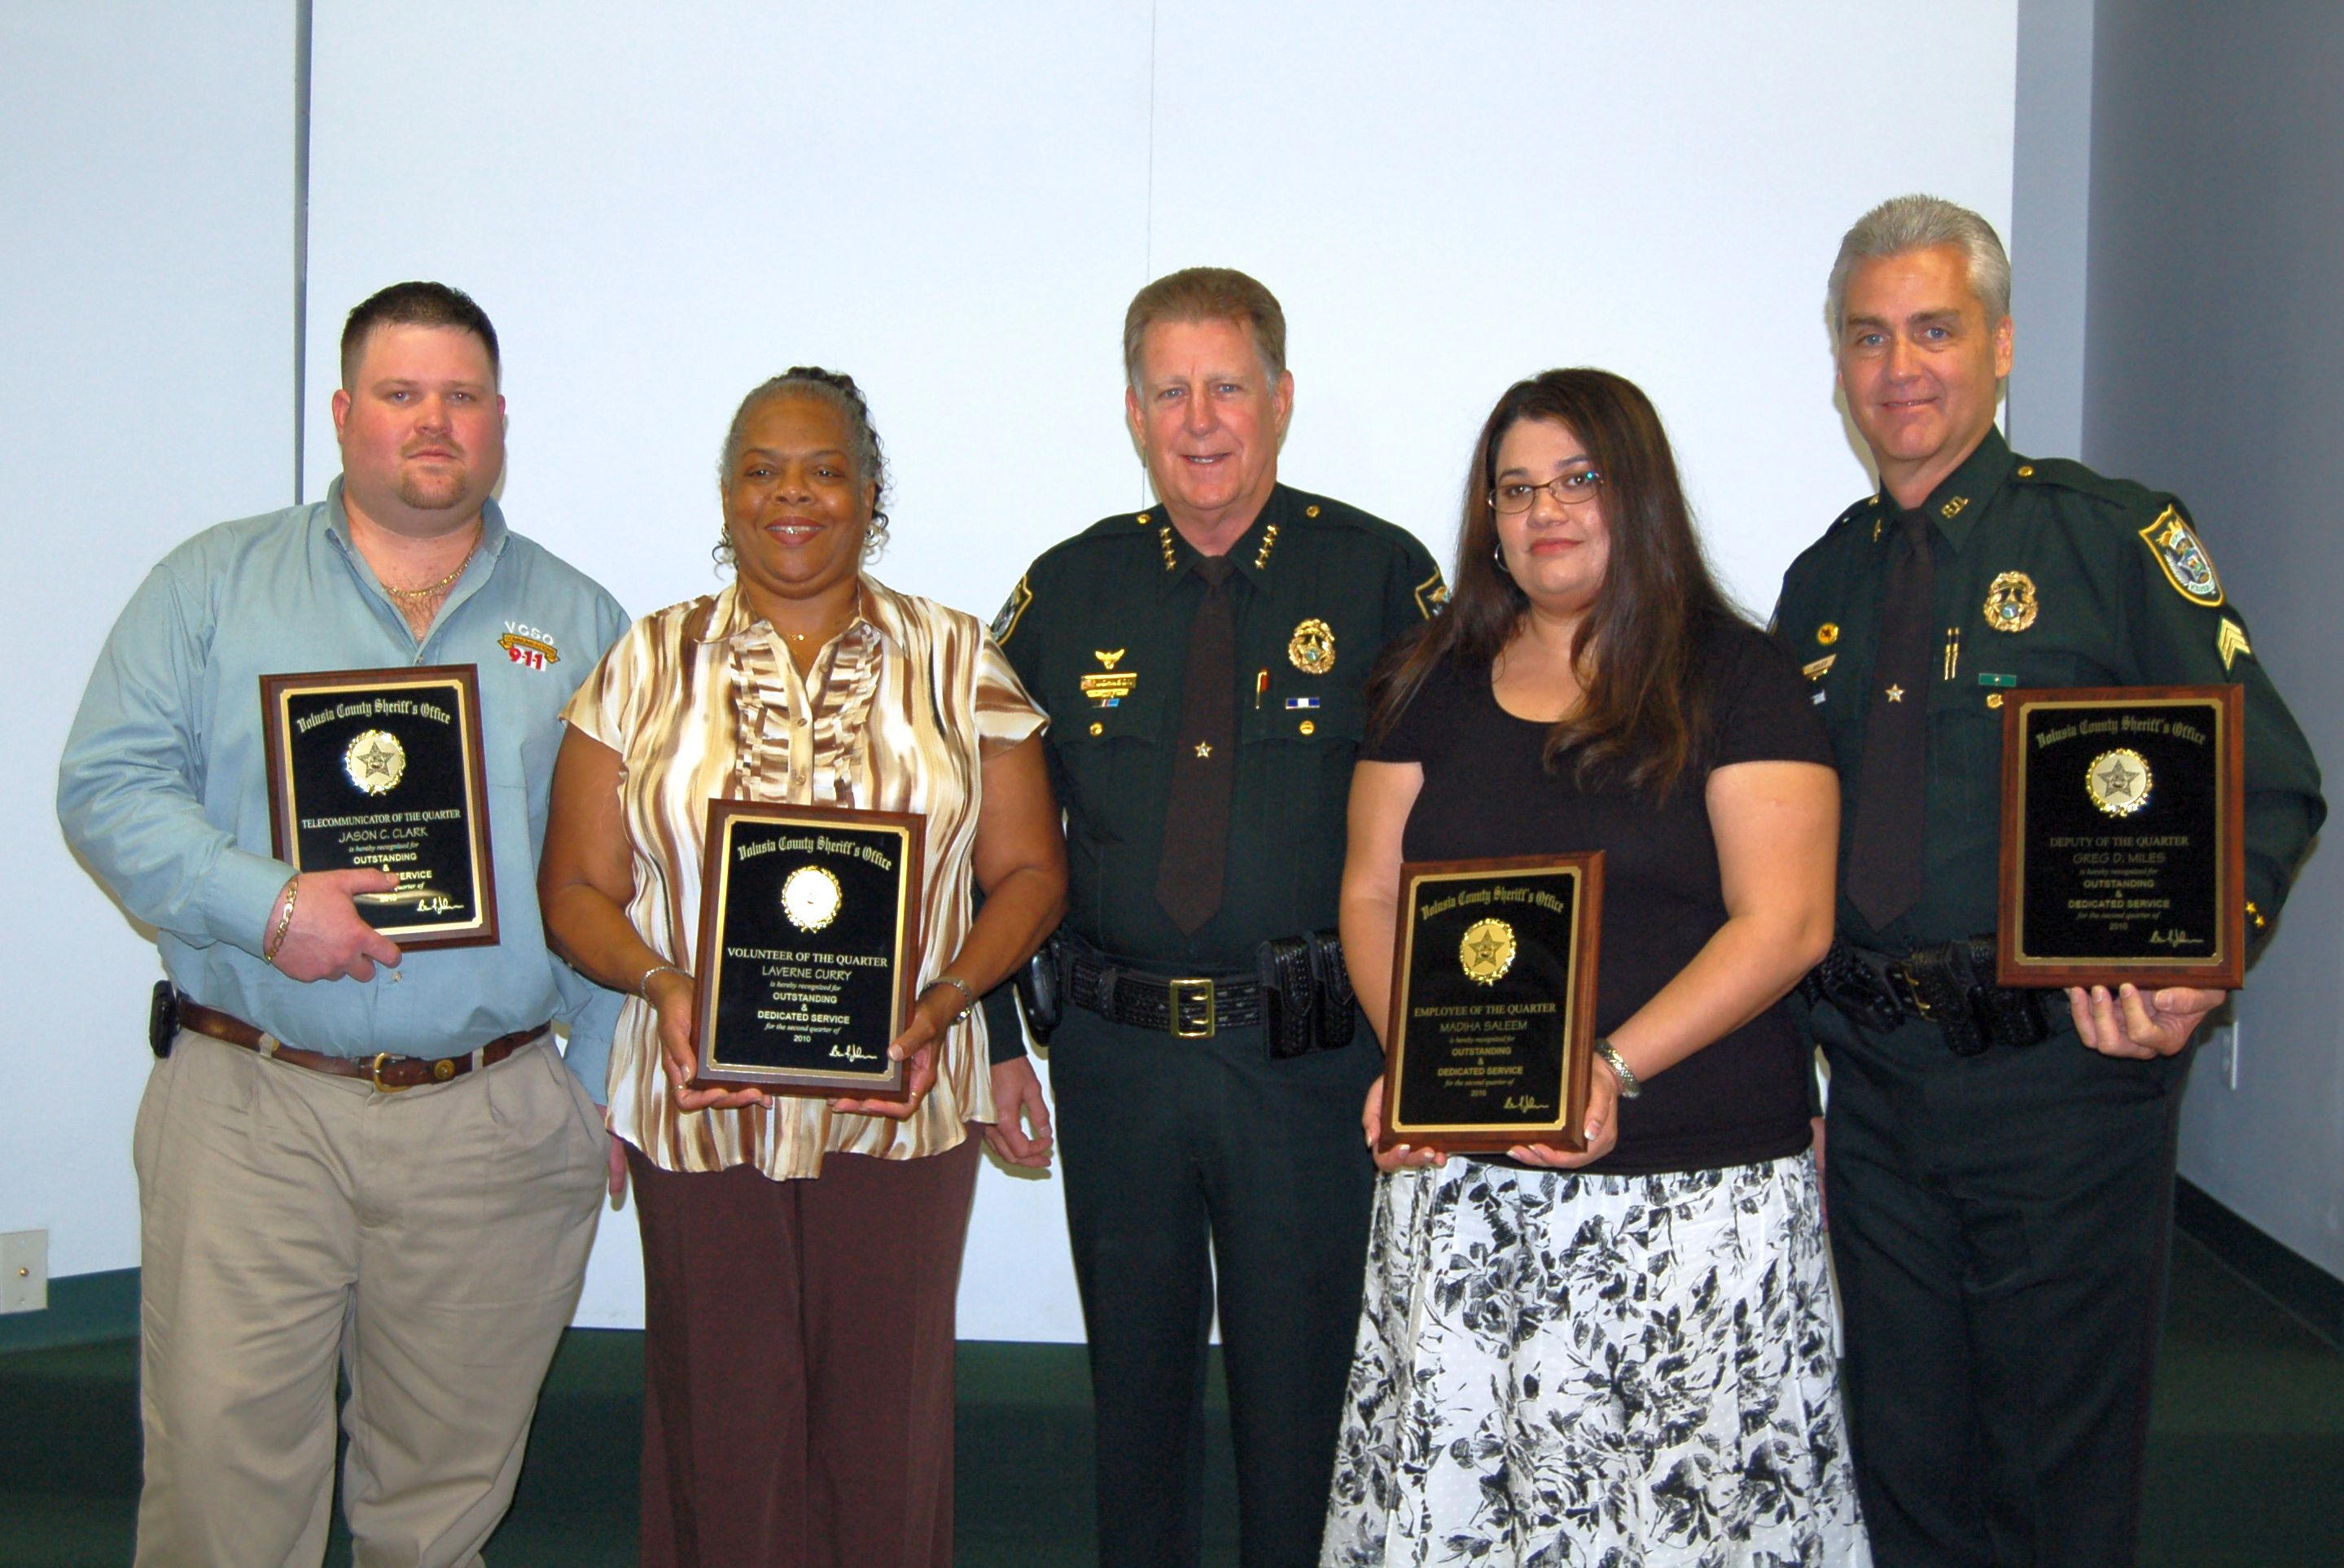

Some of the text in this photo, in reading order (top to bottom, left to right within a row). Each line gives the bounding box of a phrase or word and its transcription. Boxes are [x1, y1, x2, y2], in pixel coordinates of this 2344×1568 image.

[504, 620, 554, 646] VCSO
[296, 698, 450, 733] Volusia County Sheriff's Office
[2035, 715, 2206, 749] Volusia County Sheriff's Office
[301, 809, 461, 829] TELECOMMUNICATOR OF THE QUARTER
[339, 826, 428, 843] JASON C. CLARK
[2049, 835, 2189, 848] DEPUTY OF THE QUARTER
[353, 853, 418, 865] OUTSTANDING
[738, 835, 892, 871] Volusia County Sheriff's Office
[2072, 852, 2167, 865] GREG D. MILES
[383, 864, 390, 872] &
[2083, 879, 2155, 888] OUTSTANDING
[1421, 885, 1564, 921] Volusia County Sheriff's Office
[2068, 899, 2171, 909] DEDICATED SERVICE
[727, 947, 888, 968] VOLUNTEER OF THE QUARTER
[762, 965, 852, 981] LAVERNE CURRY
[777, 980, 797, 990] hereby
[798, 983, 831, 992] recognized
[773, 992, 838, 1005] OUTSTANDING
[800, 1003, 808, 1012] &
[1413, 1002, 1557, 1018] EMPLOYEE OF THE QUARTER
[757, 1010, 851, 1025] DEDICATED SERVICE
[764, 1022, 775, 1031] for
[776, 1023, 786, 1031] the
[809, 1027, 832, 1035] quarter
[1439, 1019, 1528, 1034] MADIHA SALEEM
[793, 1035, 812, 1044] 2010
[1451, 1046, 1512, 1057] OUTSTANDING
[1437, 1066, 1524, 1077] DEDICATED SERVICE
